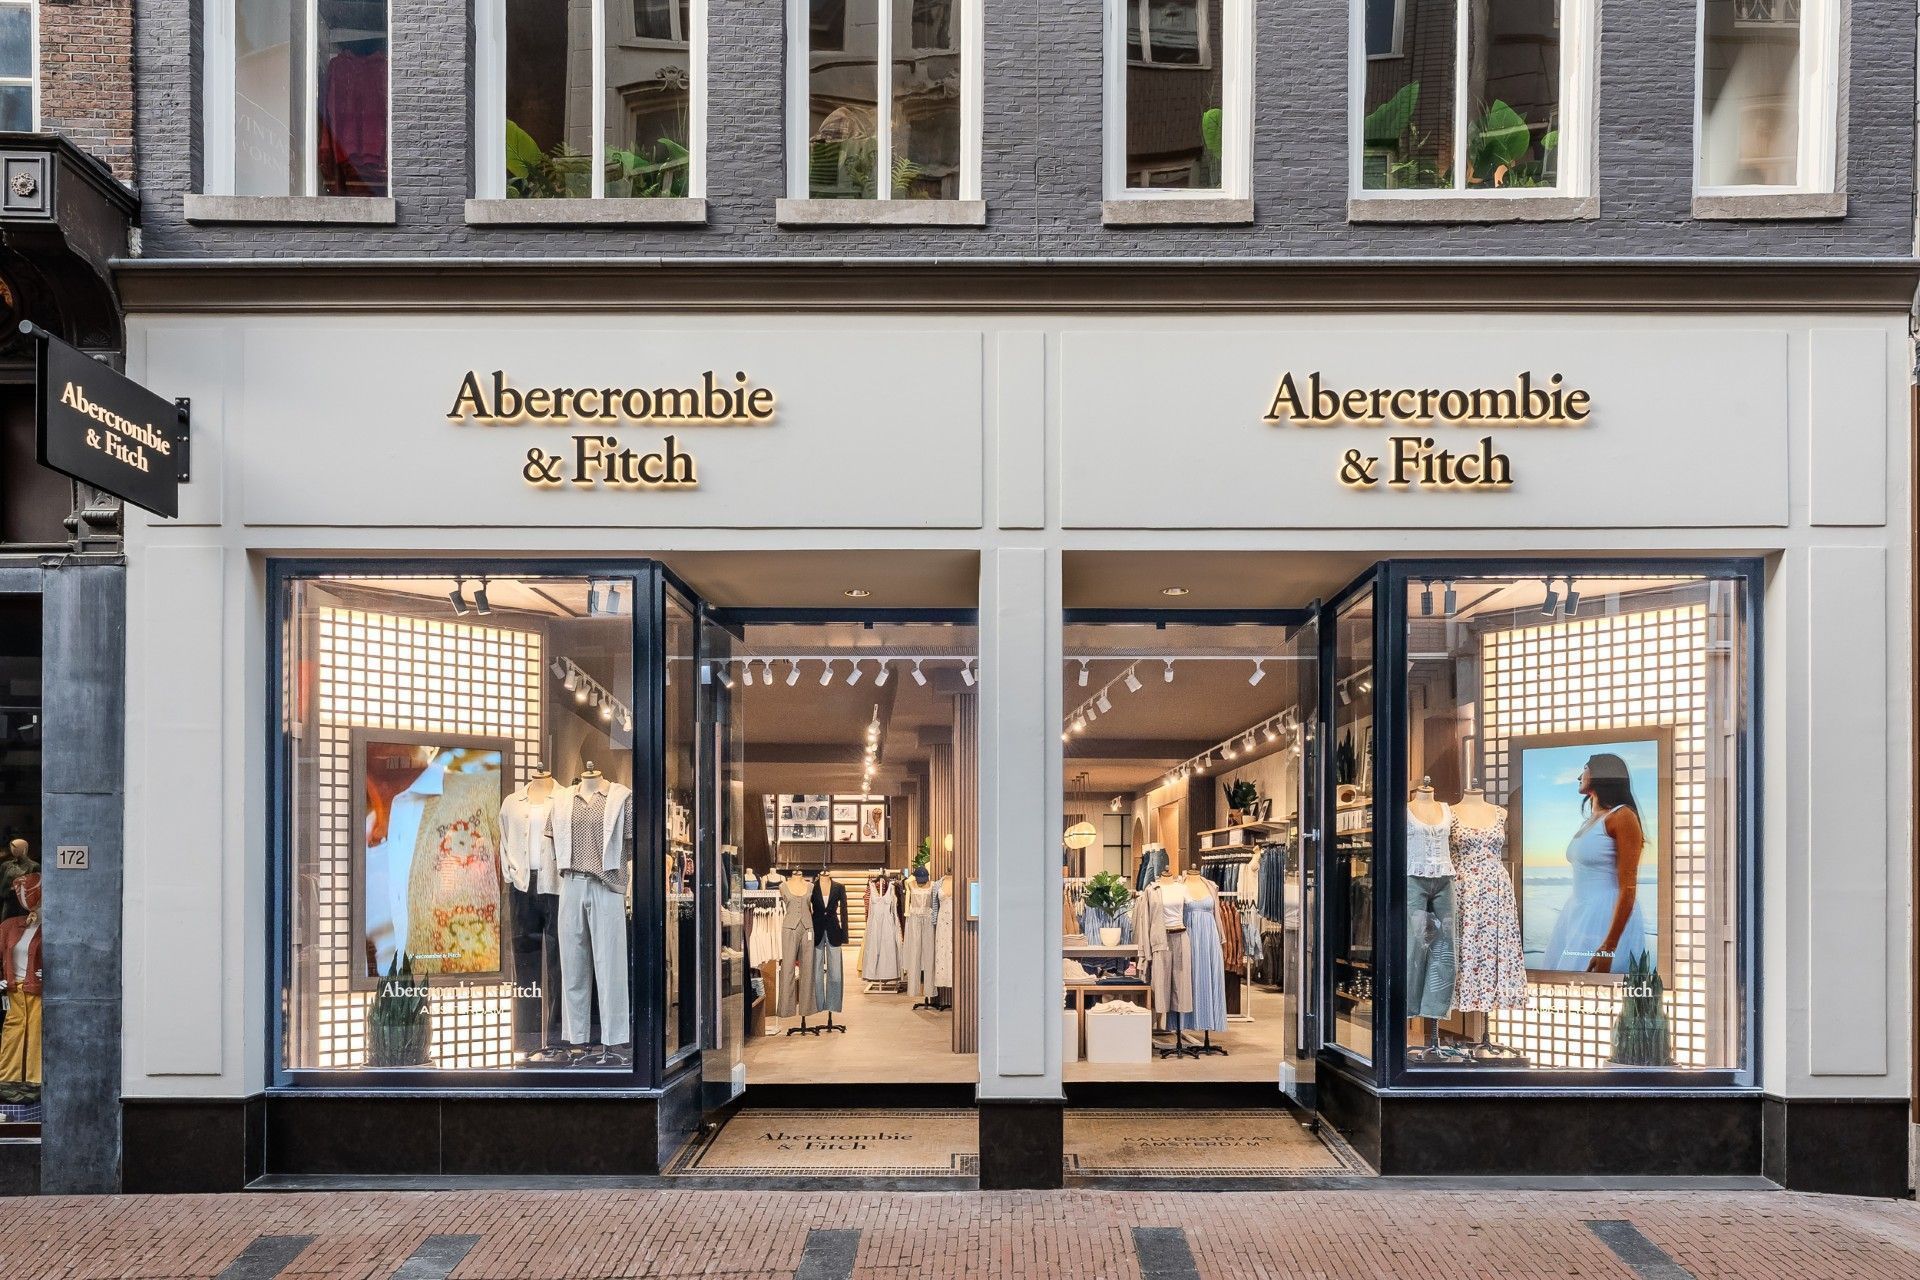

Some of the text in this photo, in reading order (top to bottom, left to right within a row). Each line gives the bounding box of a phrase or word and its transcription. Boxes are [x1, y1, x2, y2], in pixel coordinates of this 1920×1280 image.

[447, 370, 774, 419] Abercrombie
[1263, 371, 1591, 420] Abercrombie
[60, 381, 171, 456] Abercrombie
[86, 428, 150, 473] & Fitch
[522, 435, 697, 484] & Fitch
[1340, 436, 1514, 485] & Fitch
[60, 850, 85, 865] 172
[502, 981, 542, 998] Fitch
[1613, 981, 1653, 998] Fitch
[756, 1132, 913, 1141] Abercrombie
[804, 1142, 869, 1150] Fitch
